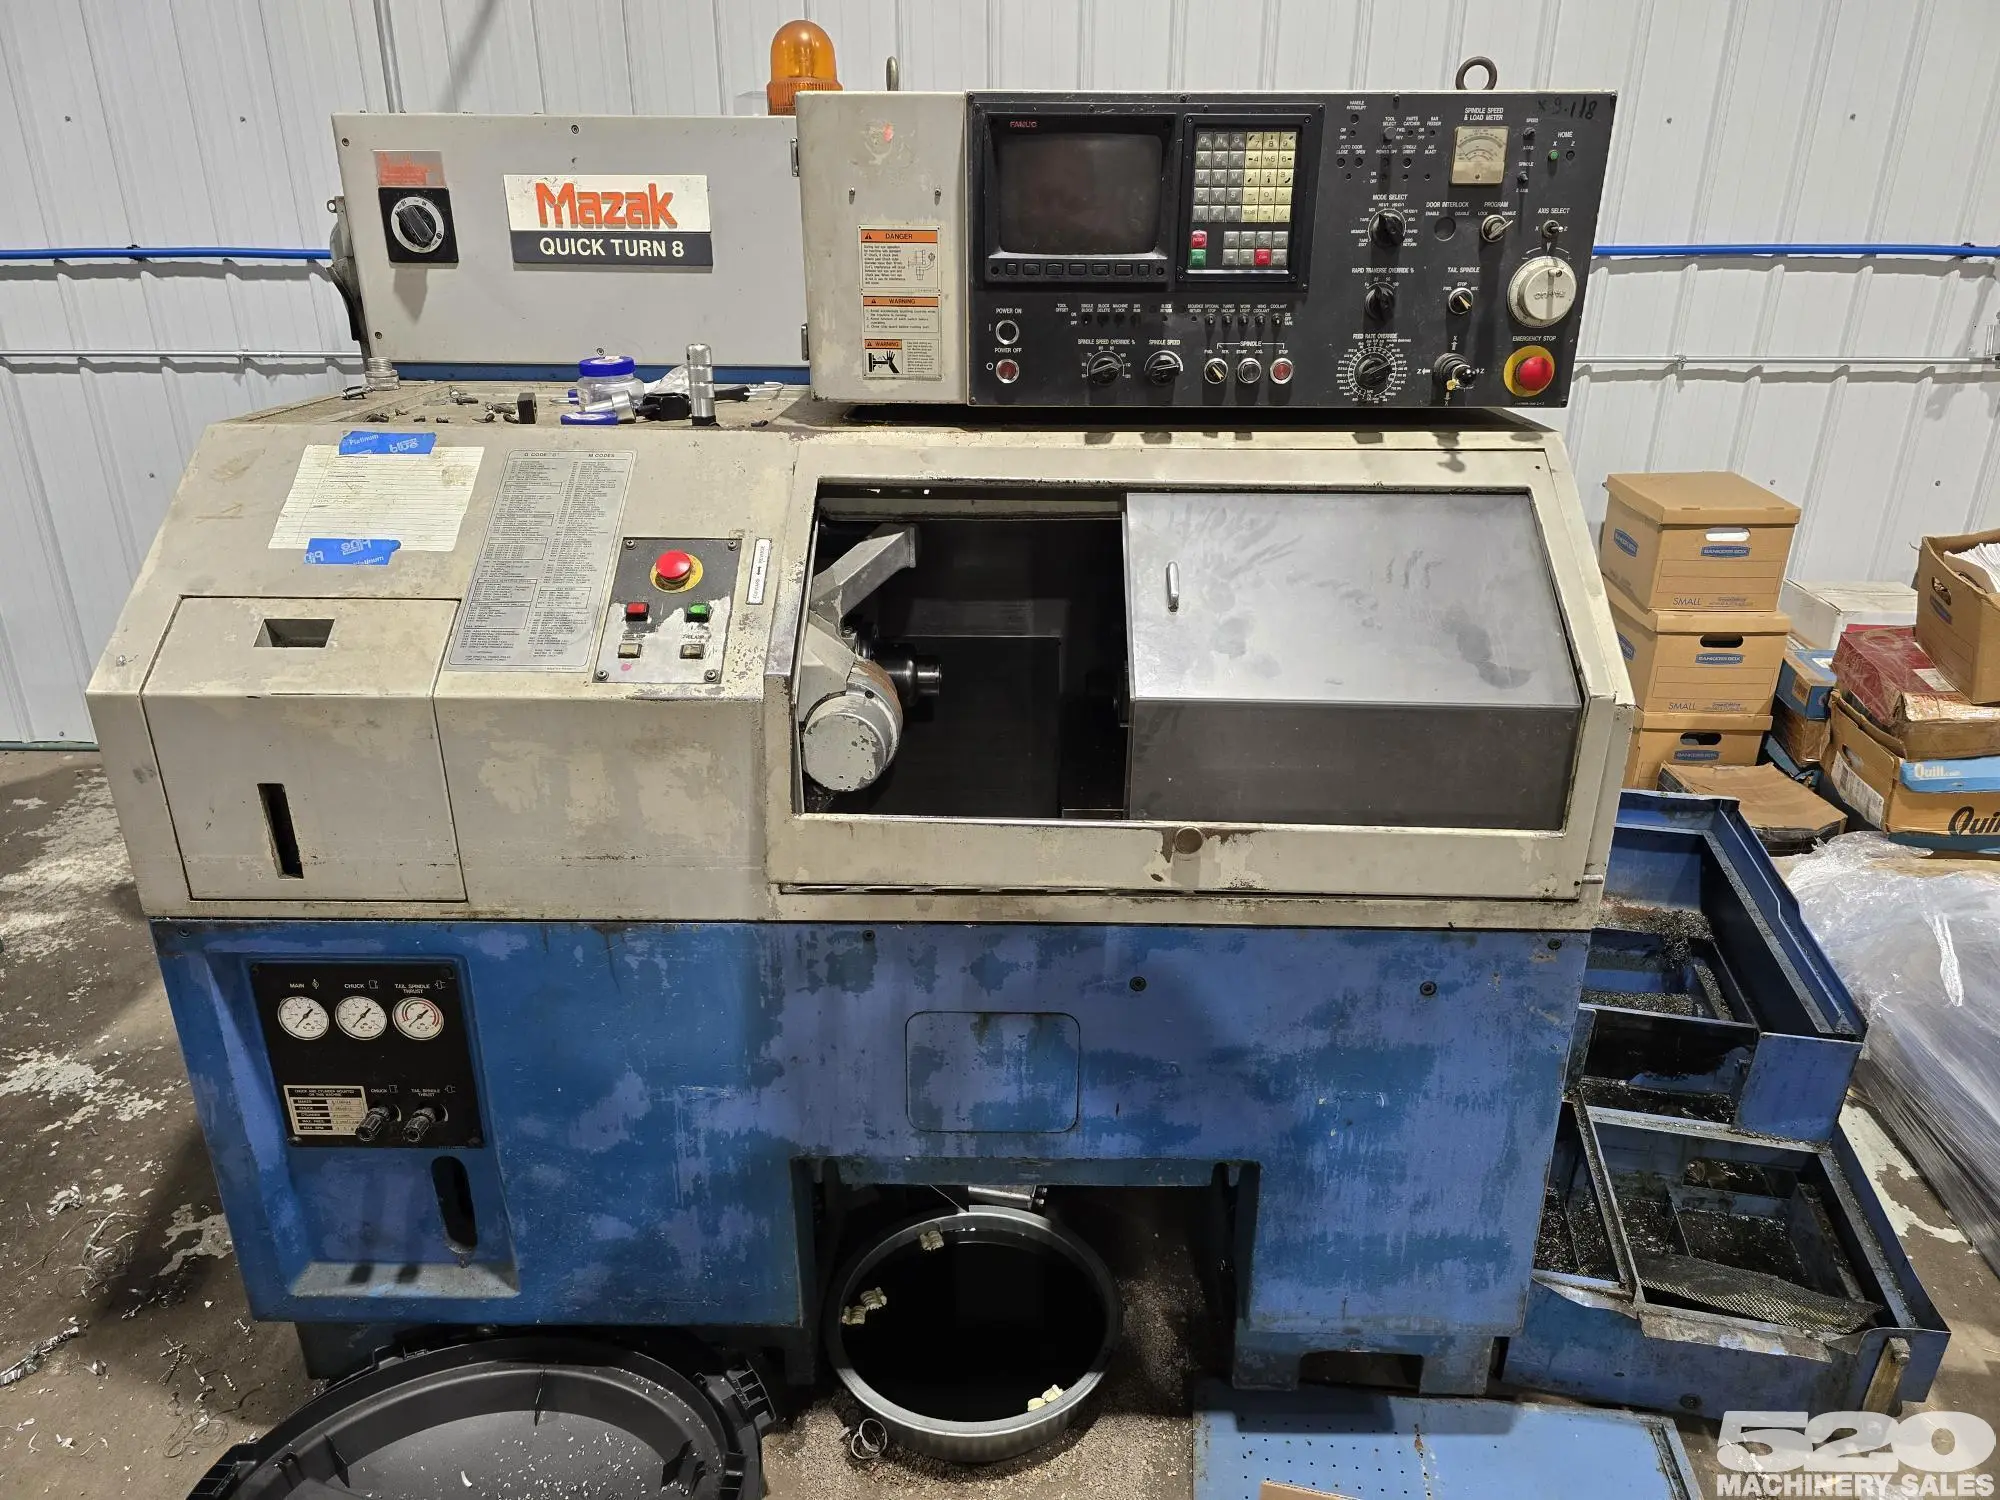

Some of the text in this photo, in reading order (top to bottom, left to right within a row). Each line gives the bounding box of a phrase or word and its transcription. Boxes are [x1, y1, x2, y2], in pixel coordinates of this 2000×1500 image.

[535, 182, 678, 229] Mazak
[539, 236, 685, 258] QUICK TURN 8
[349, 434, 379, 445] Platinum
[1673, 597, 1701, 606] SMALL
[1668, 702, 1697, 711] SMALL
[1914, 763, 1962, 778] Quill.com
